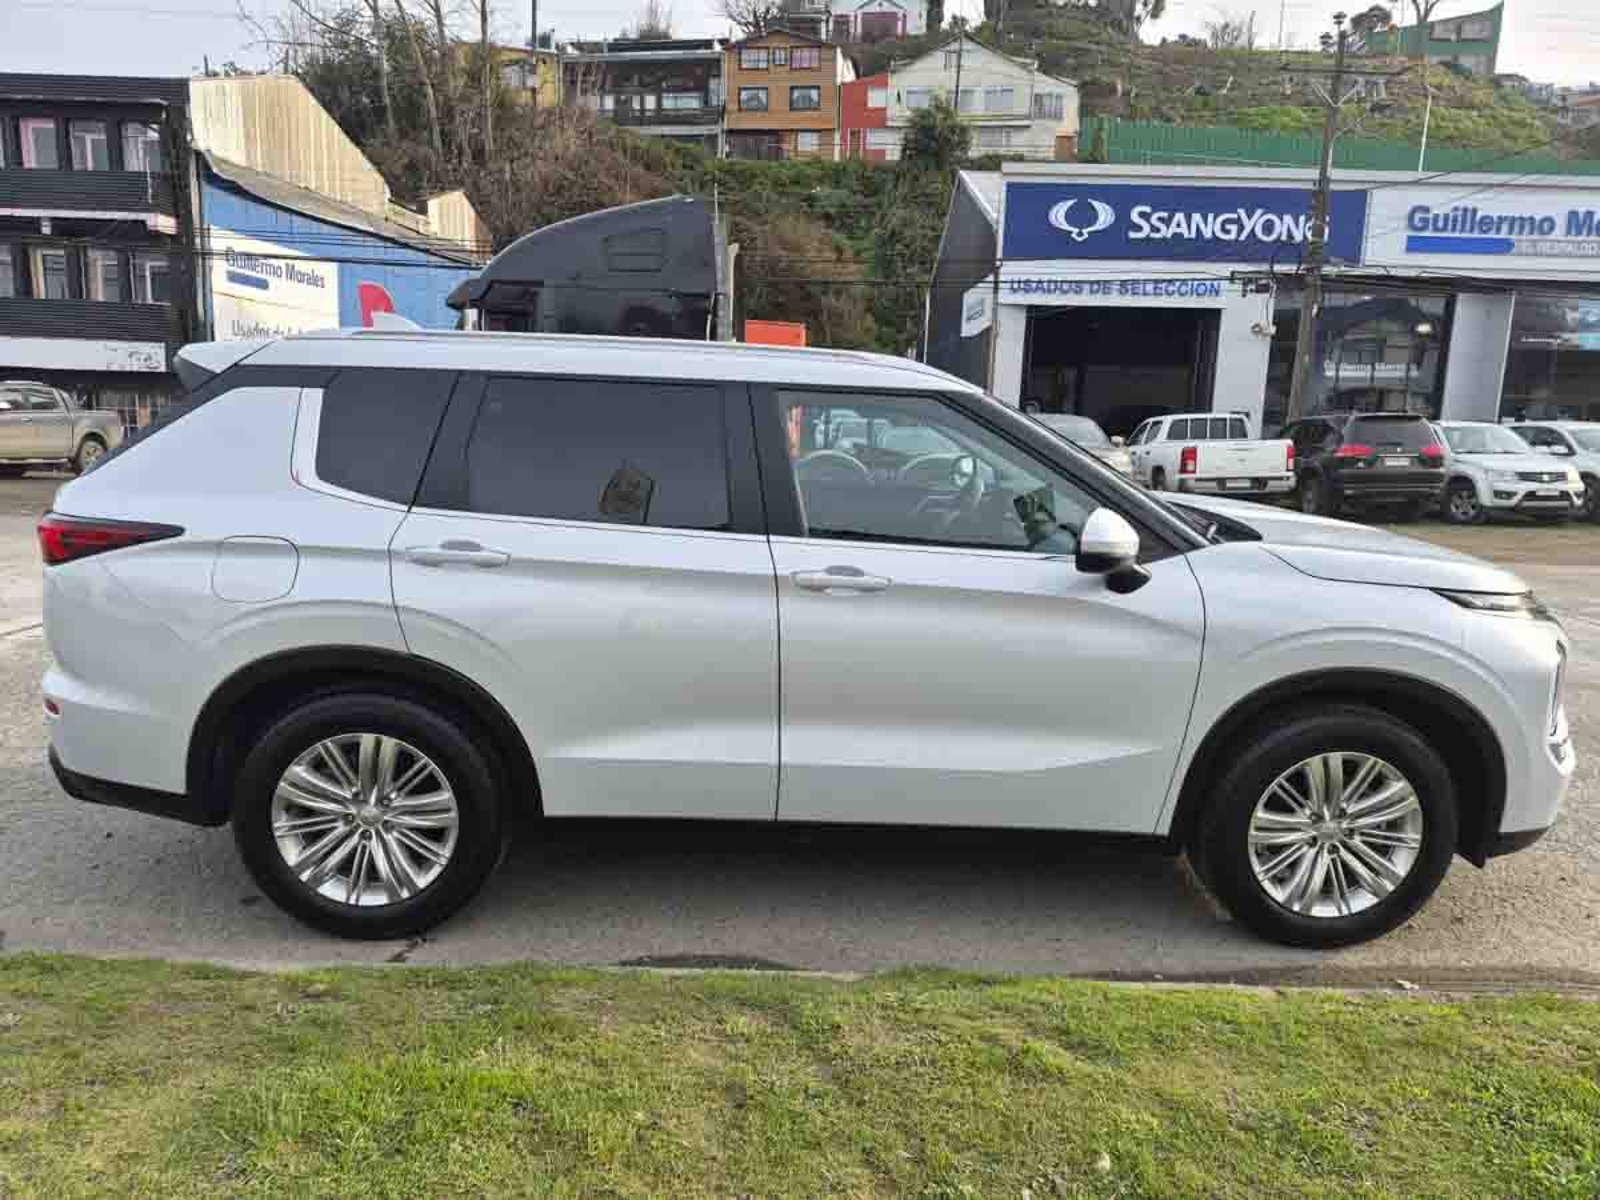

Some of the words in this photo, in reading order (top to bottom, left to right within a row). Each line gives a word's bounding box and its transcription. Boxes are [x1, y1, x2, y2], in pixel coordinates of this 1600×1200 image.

[1407, 204, 1556, 236] Guillermo
[225, 246, 283, 279] Guillermo
[284, 262, 325, 289] Morales
[1010, 278, 1082, 295] USADOS
[1089, 279, 1113, 295] DE
[1119, 279, 1220, 297] SELECCION
